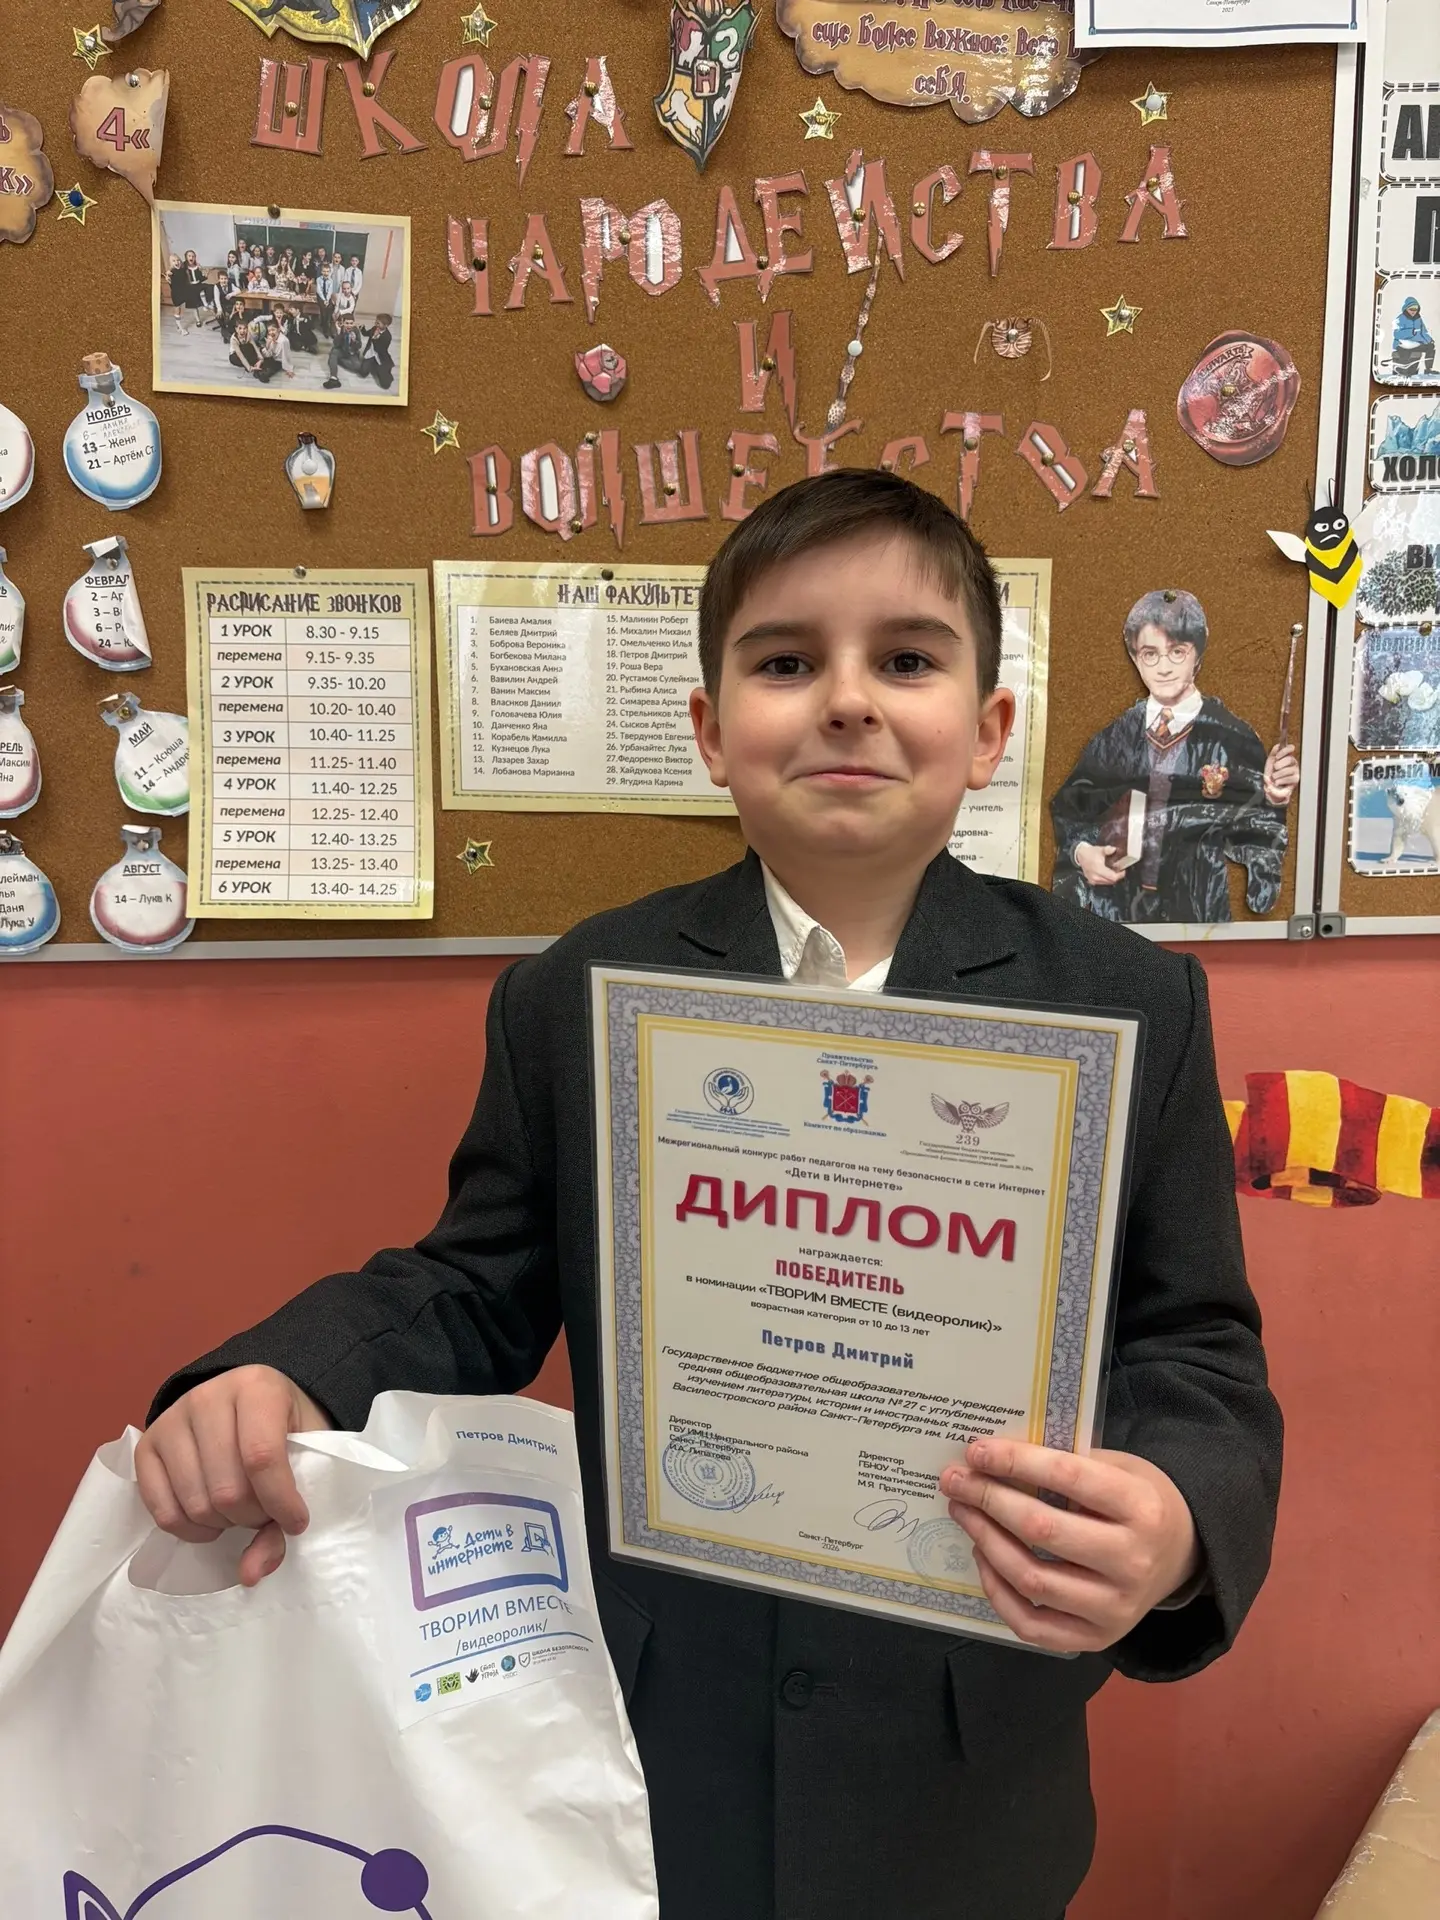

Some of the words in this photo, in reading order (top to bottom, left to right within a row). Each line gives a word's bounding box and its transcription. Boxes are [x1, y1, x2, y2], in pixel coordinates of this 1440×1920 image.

[250, 49, 635, 186] ШКОЛА
[447, 144, 1189, 324] ЧАРОДЕЙСТВА
[733, 308, 800, 432] И
[85, 404, 132, 423] НОЯБРЬ
[82, 442, 98, 455] 13
[108, 435, 137, 450] Женя
[86, 459, 102, 471] 21
[113, 450, 145, 466] Артём
[1382, 456, 1440, 483] ХОЛ
[84, 574, 130, 588] ФЕВРАЛ
[206, 591, 320, 616] РАСПИСАНИЕ
[327, 594, 402, 614] ЗВОНКОВ
[557, 583, 600, 604] НАШ
[220, 624, 229, 637] 1
[233, 624, 273, 638] УРОК
[305, 625, 337, 640] 8.30
[349, 626, 380, 640] 9.15
[217, 651, 283, 663] перемена
[305, 651, 341, 664] 9.15-
[345, 651, 375, 665] 9.35
[606, 649, 618, 658] 18.
[619, 650, 650, 660] Петров
[650, 650, 688, 661] Дмитрий
[221, 676, 230, 689] 2
[234, 676, 274, 689] УРОК
[307, 677, 343, 690] 9.35-
[348, 677, 386, 691] 10.20
[218, 702, 284, 715] перемена
[309, 703, 353, 716] 10.20-
[358, 703, 396, 717] 10.40
[128, 722, 154, 745] МАЙ
[309, 728, 353, 741] 10.40-
[357, 729, 396, 743] 11.25
[472, 720, 485, 729] 10.
[490, 721, 531, 731] Данченко
[532, 722, 548, 731] Яна
[0, 742, 23, 752] РЕЛЬ
[223, 730, 232, 743] 3
[235, 730, 275, 744] УРОК
[134, 768, 148, 780] 11
[154, 737, 184, 764] Ксюша
[473, 755, 485, 764] 13.
[491, 755, 525, 765] Лазарев
[526, 756, 550, 766] Захар
[606, 765, 618, 774] 28.
[619, 766, 663, 776] Хайдукова
[663, 767, 693, 776] Ксения
[1362, 761, 1425, 781] Белый
[122, 863, 162, 875] АВГУСТ
[115, 895, 127, 904] 14
[165, 894, 173, 903] К
[955, 1134, 981, 1147] 239
[657, 1135, 740, 1154] Межрегиональный
[742, 1148, 778, 1160] конкурс
[780, 1153, 806, 1163] работ
[808, 1157, 856, 1170] педагогов
[858, 1164, 870, 1172] на
[872, 1166, 895, 1177] тему
[896, 1168, 963, 1185] безопасности
[973, 1180, 996, 1189] сети
[998, 1182, 1046, 1196] Интернет
[785, 1167, 820, 1180] «Дети
[823, 1173, 830, 1182] в
[833, 1173, 903, 1191] Интернете»
[676, 1174, 1017, 1262] ДИПЛОМ
[798, 1247, 883, 1267] награждается:
[775, 1259, 905, 1295] ПОБЕДИТЕЛЬ
[686, 1275, 693, 1283] в
[695, 1276, 756, 1293] номинации
[758, 1283, 827, 1304] «ТВОРИМ
[830, 1294, 889, 1315] ВМЕСТЕ
[892, 1304, 1003, 1333] (видеоролик)»
[750, 1301, 805, 1316] возрастная
[806, 1310, 857, 1324] категория
[872, 1319, 883, 1329] 10
[884, 1323, 898, 1331] до
[900, 1324, 910, 1333] 13
[911, 1328, 931, 1336] лет
[762, 1329, 826, 1354] Петров
[831, 1341, 914, 1370] Дмитрий
[661, 1345, 754, 1369] Государственное
[756, 1362, 820, 1381] бюджетное
[821, 1375, 950, 1404] общеобразовательное
[950, 1398, 1025, 1417] учреждение
[677, 1361, 723, 1376] средняя
[724, 1370, 848, 1398] общеобразовательная
[849, 1392, 886, 1404] школа
[927, 1406, 1007, 1426] углубленным
[672, 1381, 776, 1408] Василеостровского
[776, 1403, 818, 1416] района
[819, 1408, 923, 1435] Санкт-Петербурга
[924, 1429, 941, 1438] им.
[687, 1375, 745, 1391] изучением
[745, 1385, 812, 1404] литературы,
[815, 1398, 862, 1412] истории
[863, 1406, 873, 1414] и
[873, 1408, 950, 1428] иностранных
[951, 1422, 995, 1436] языков
[668, 1415, 712, 1430] Директор
[455, 1430, 504, 1442] Петров
[507, 1433, 559, 1456] Дмитрий
[669, 1424, 686, 1434] ГБУ
[775, 1445, 809, 1457] района
[669, 1434, 751, 1456] Санкт-Петербурга
[858, 1450, 905, 1466] Директор
[858, 1460, 889, 1472] ГБНОУ
[857, 1471, 937, 1491] математический
[878, 1483, 935, 1500] Пратусевич
[463, 1528, 503, 1548] Дети
[798, 1530, 864, 1550] Санкт-Петербург
[427, 1538, 514, 1577] интернете
[419, 1603, 500, 1642] ТВОРИМ
[505, 1594, 574, 1618] ВМЕСТЕ
[455, 1619, 548, 1656] /видеоролик/
